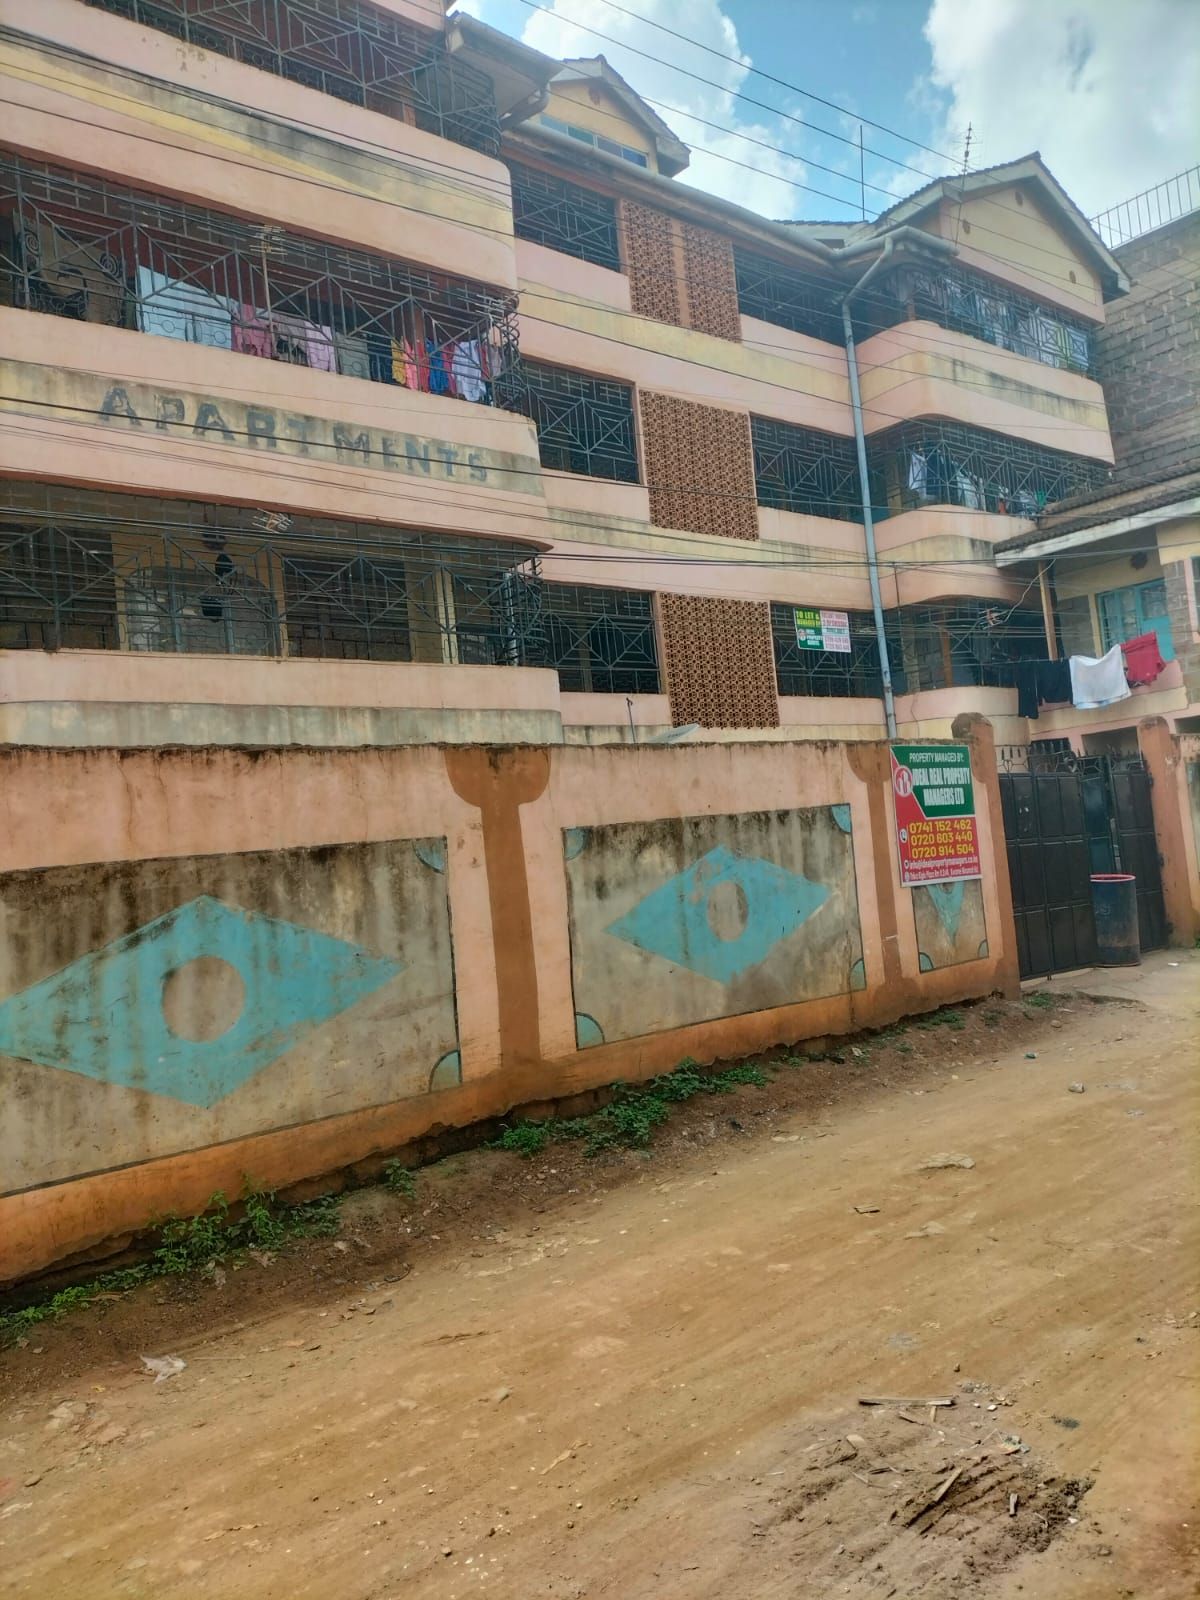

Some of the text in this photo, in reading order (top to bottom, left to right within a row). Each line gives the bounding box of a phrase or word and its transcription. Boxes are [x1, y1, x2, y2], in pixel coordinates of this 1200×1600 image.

[97, 387, 488, 482] APARTMENTS
[909, 752, 935, 763] PROPERTY
[935, 752, 956, 763] MANAGED
[943, 768, 970, 785] PROPERTY
[924, 788, 954, 806] MANAGERS
[909, 822, 932, 834] 0741
[935, 820, 952, 831] 152
[911, 834, 934, 846] 0720
[955, 831, 973, 842] 440
[912, 843, 975, 859] 0720 914 504
